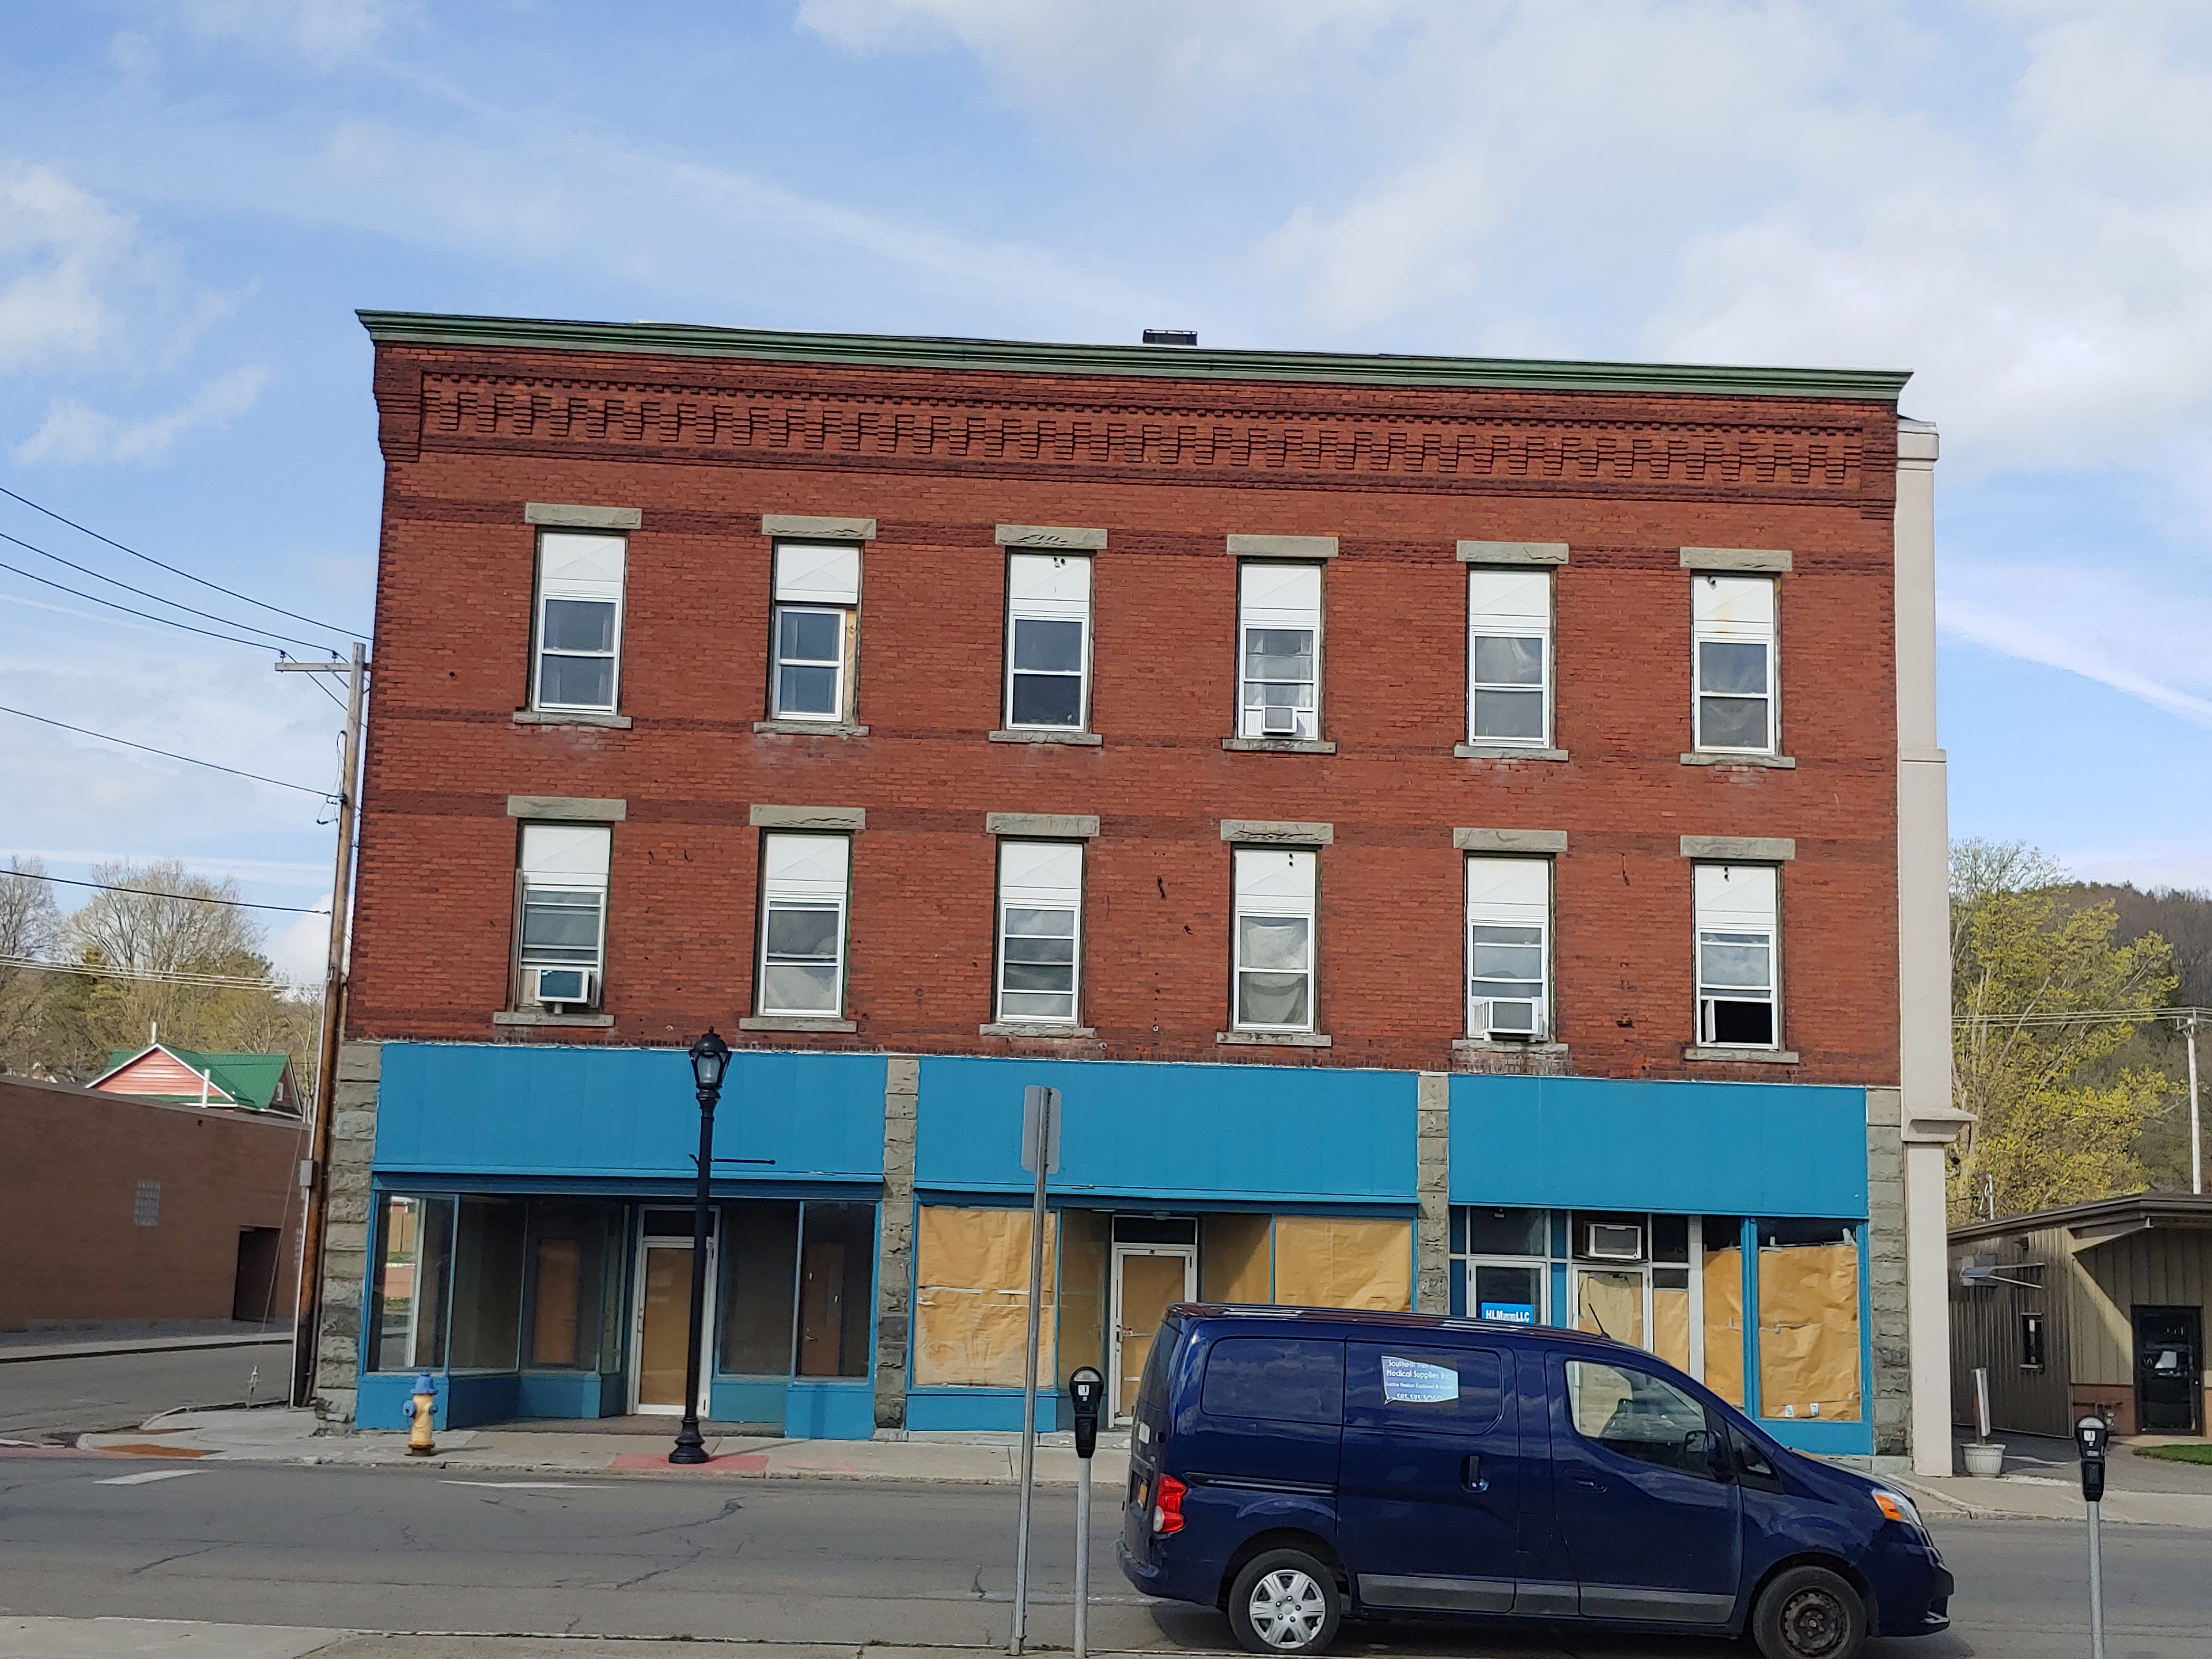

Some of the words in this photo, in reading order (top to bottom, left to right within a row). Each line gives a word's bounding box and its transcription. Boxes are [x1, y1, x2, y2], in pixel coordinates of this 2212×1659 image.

[1486, 1309, 1503, 1321] HLM
[1516, 1311, 1530, 1323] LLC
[1388, 1359, 1416, 1368] Southern
[1387, 1369, 1412, 1377] Medical
[1413, 1370, 1439, 1380] Supplies
